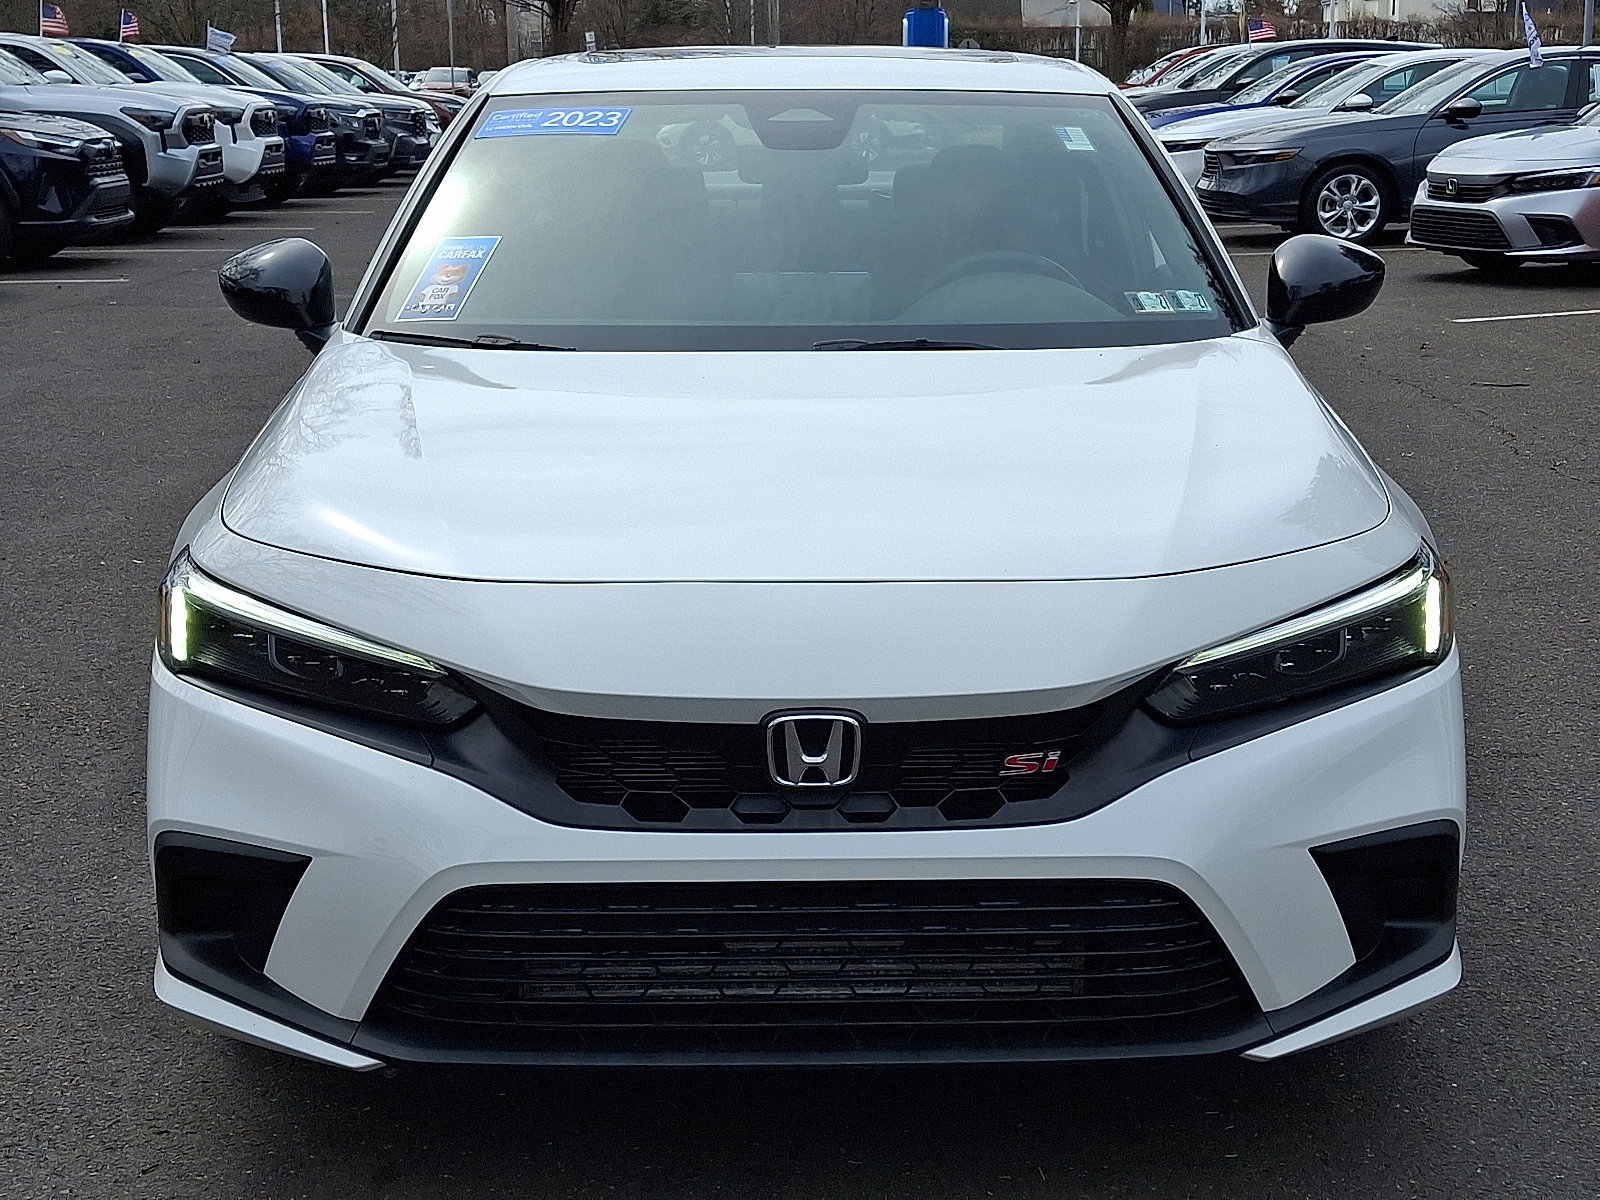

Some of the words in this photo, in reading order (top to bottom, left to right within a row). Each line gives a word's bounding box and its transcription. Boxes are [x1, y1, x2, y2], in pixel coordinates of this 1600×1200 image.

[492, 111, 543, 121] Certified
[541, 111, 622, 127] 2023
[438, 249, 486, 259] CARFAX
[999, 750, 1061, 777] Si
